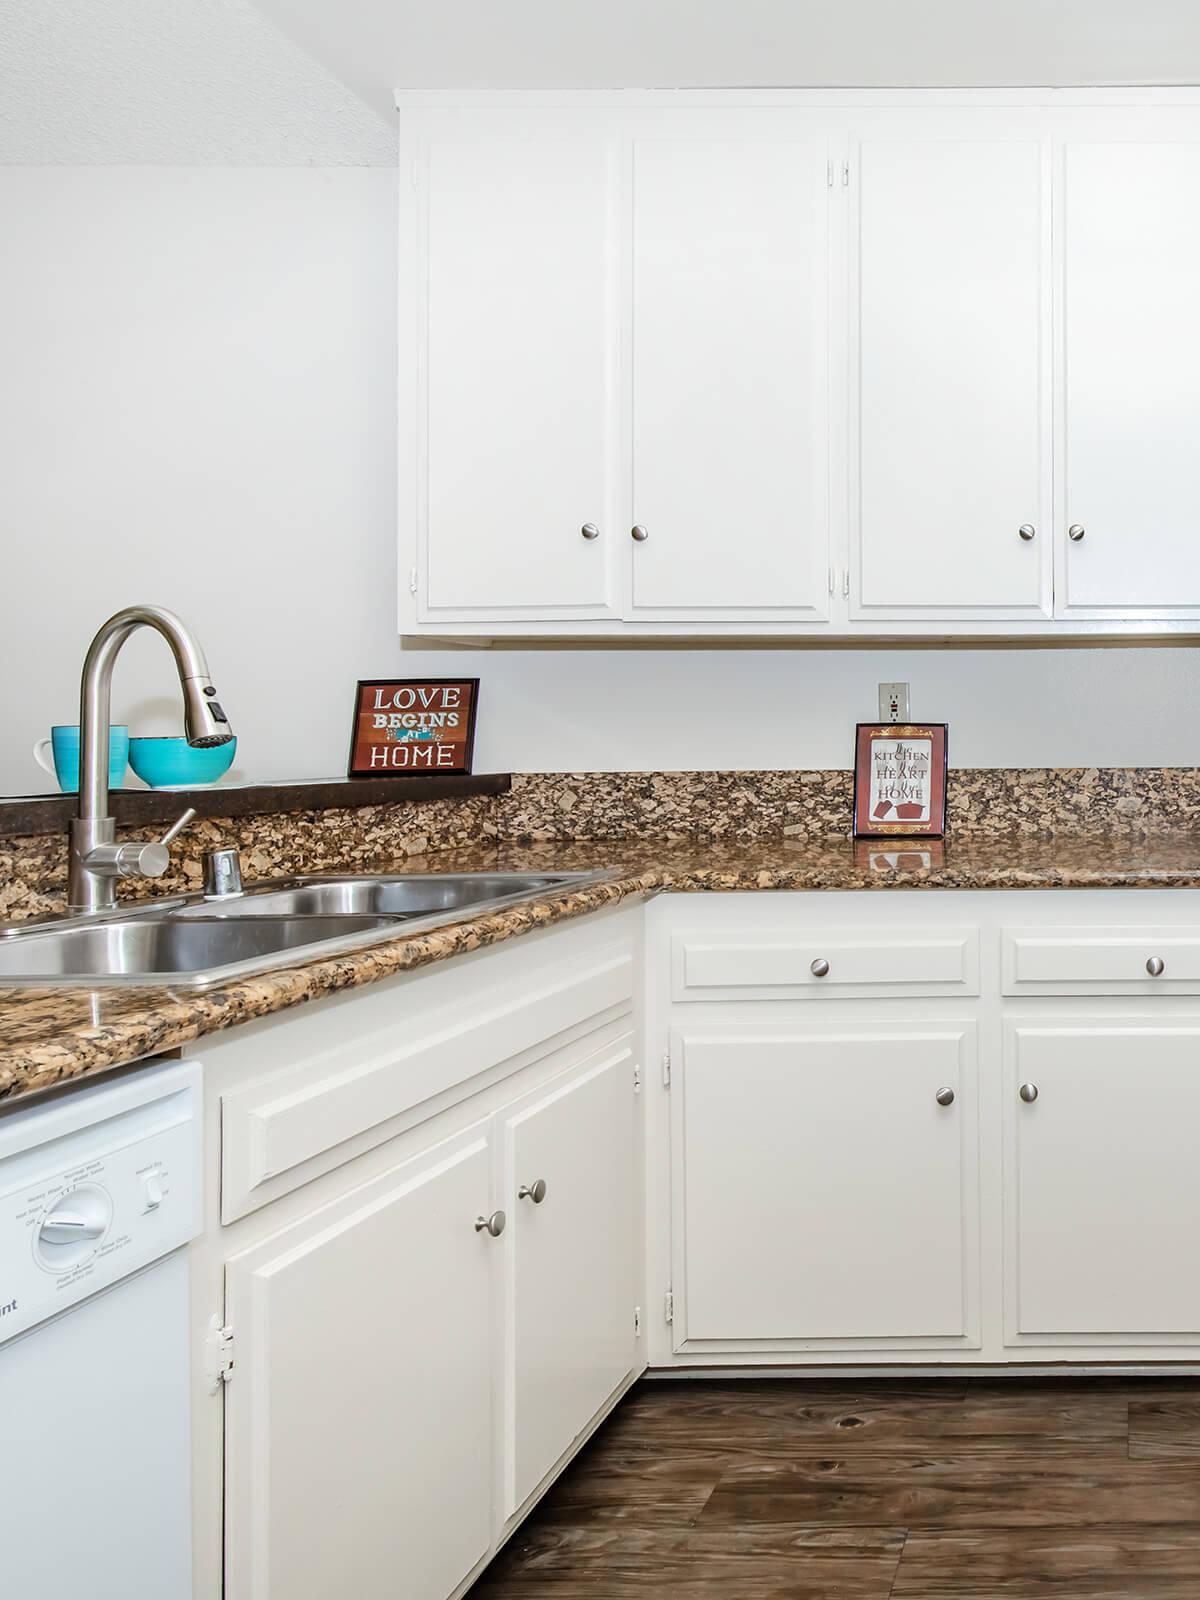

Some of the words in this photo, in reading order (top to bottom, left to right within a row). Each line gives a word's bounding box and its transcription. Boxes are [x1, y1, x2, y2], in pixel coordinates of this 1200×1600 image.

[373, 687, 461, 709] LOVE
[372, 712, 460, 728] BEGINS
[406, 731, 421, 739] AT
[370, 744, 455, 767] HOME
[874, 752, 929, 761] KITCHEN
[877, 769, 928, 779] HEART
[878, 789, 923, 800] HOME
